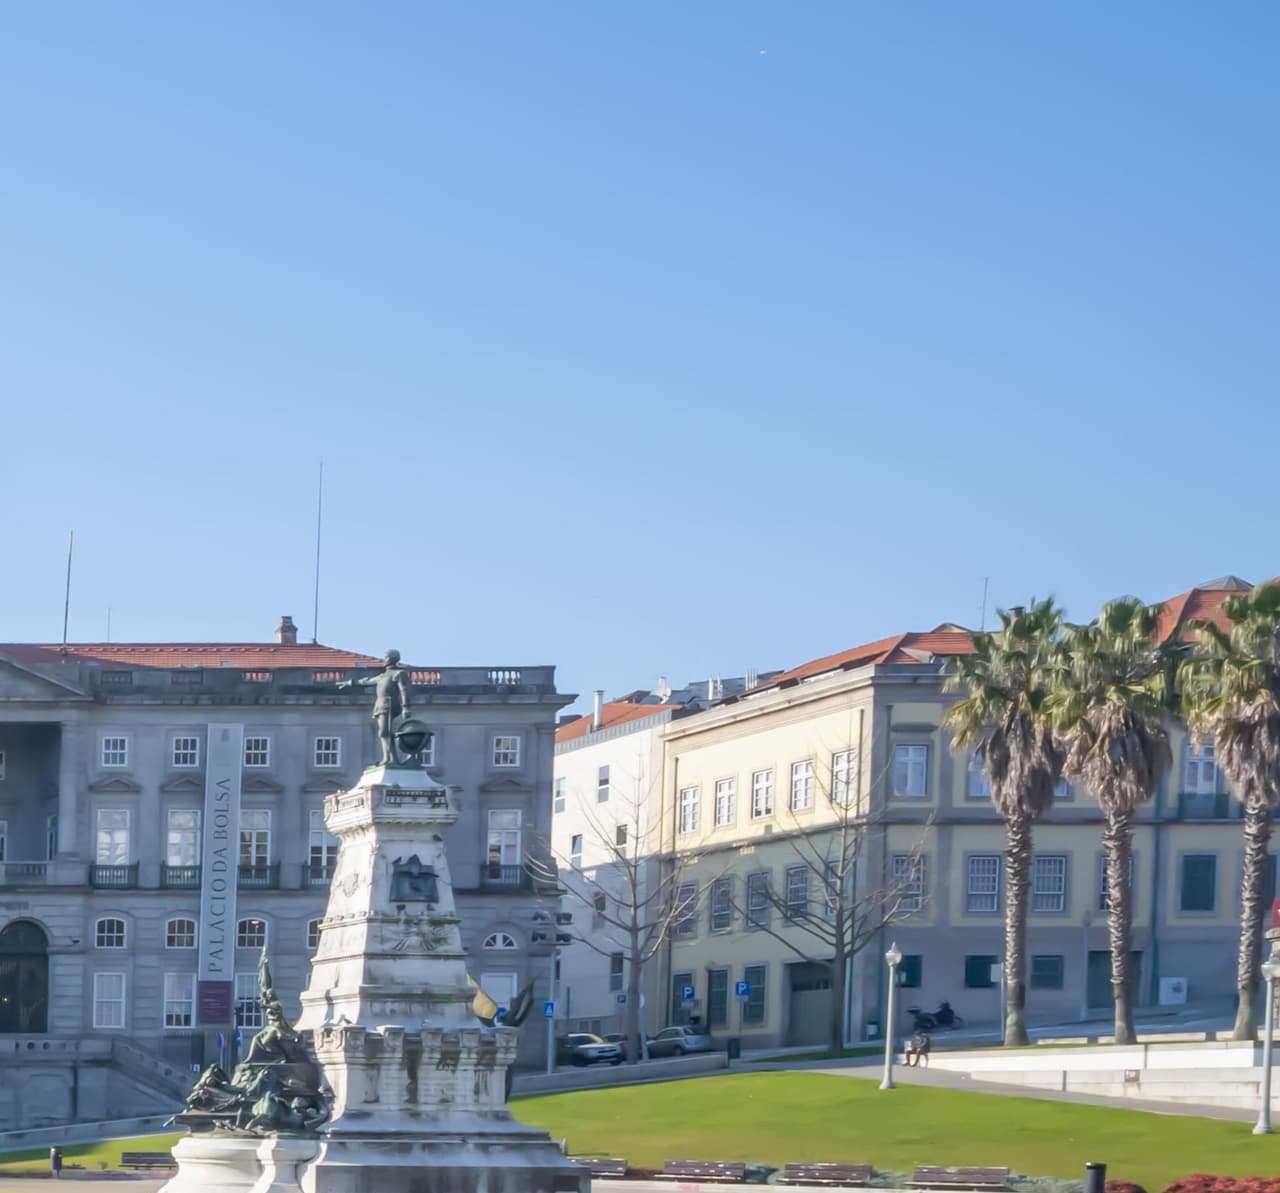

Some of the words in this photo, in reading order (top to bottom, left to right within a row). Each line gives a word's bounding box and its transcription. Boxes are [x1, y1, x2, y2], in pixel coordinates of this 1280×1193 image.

[213, 778, 231, 840] BOLSA
[212, 847, 228, 873] DA
[683, 986, 693, 999] P
[739, 983, 747, 995] P
